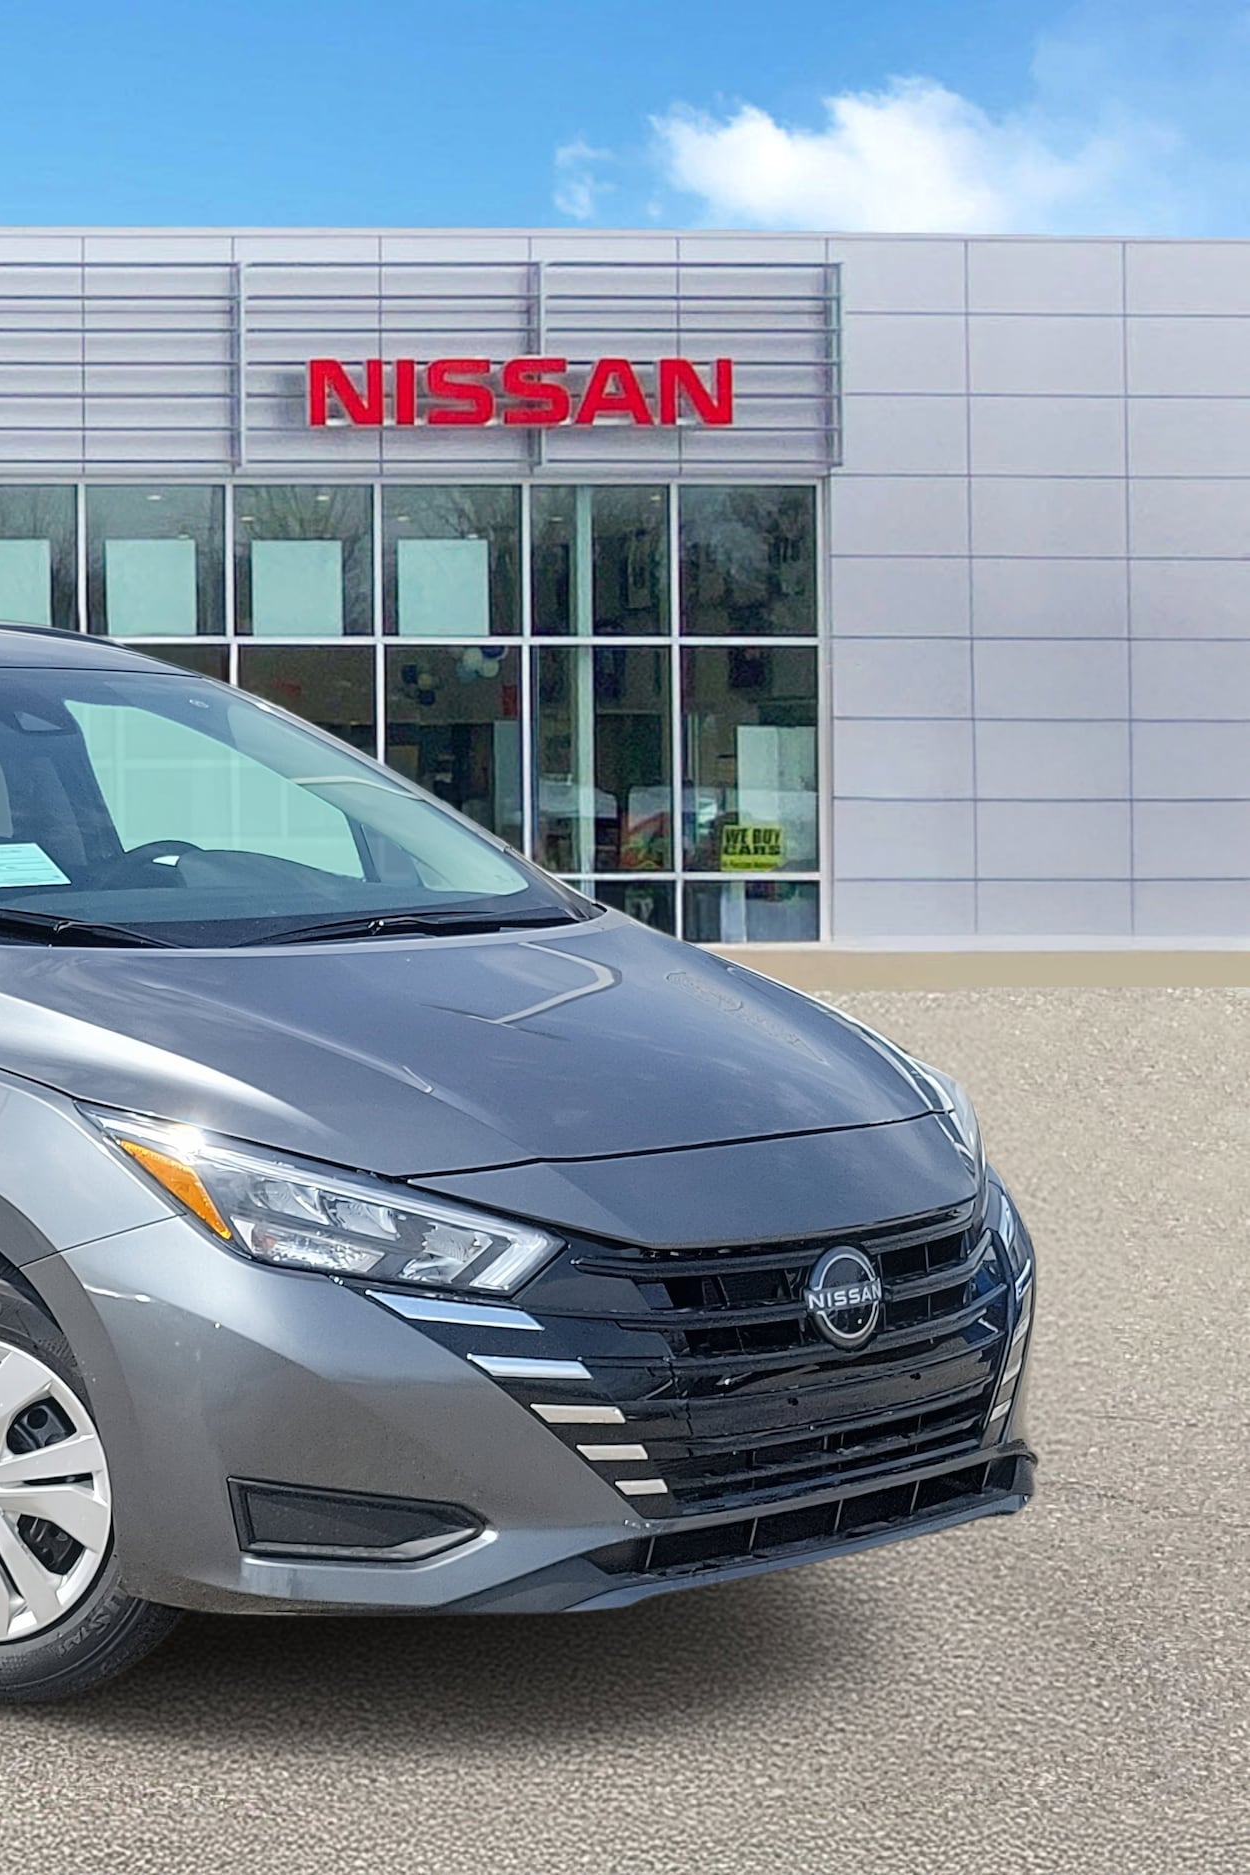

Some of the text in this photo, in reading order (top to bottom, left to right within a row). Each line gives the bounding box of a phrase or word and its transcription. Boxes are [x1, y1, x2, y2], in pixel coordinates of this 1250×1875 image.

[307, 357, 734, 427] NISSAN
[724, 828, 781, 844] WE BUY
[723, 845, 781, 855] CARS
[808, 1277, 882, 1309] NISSAN
